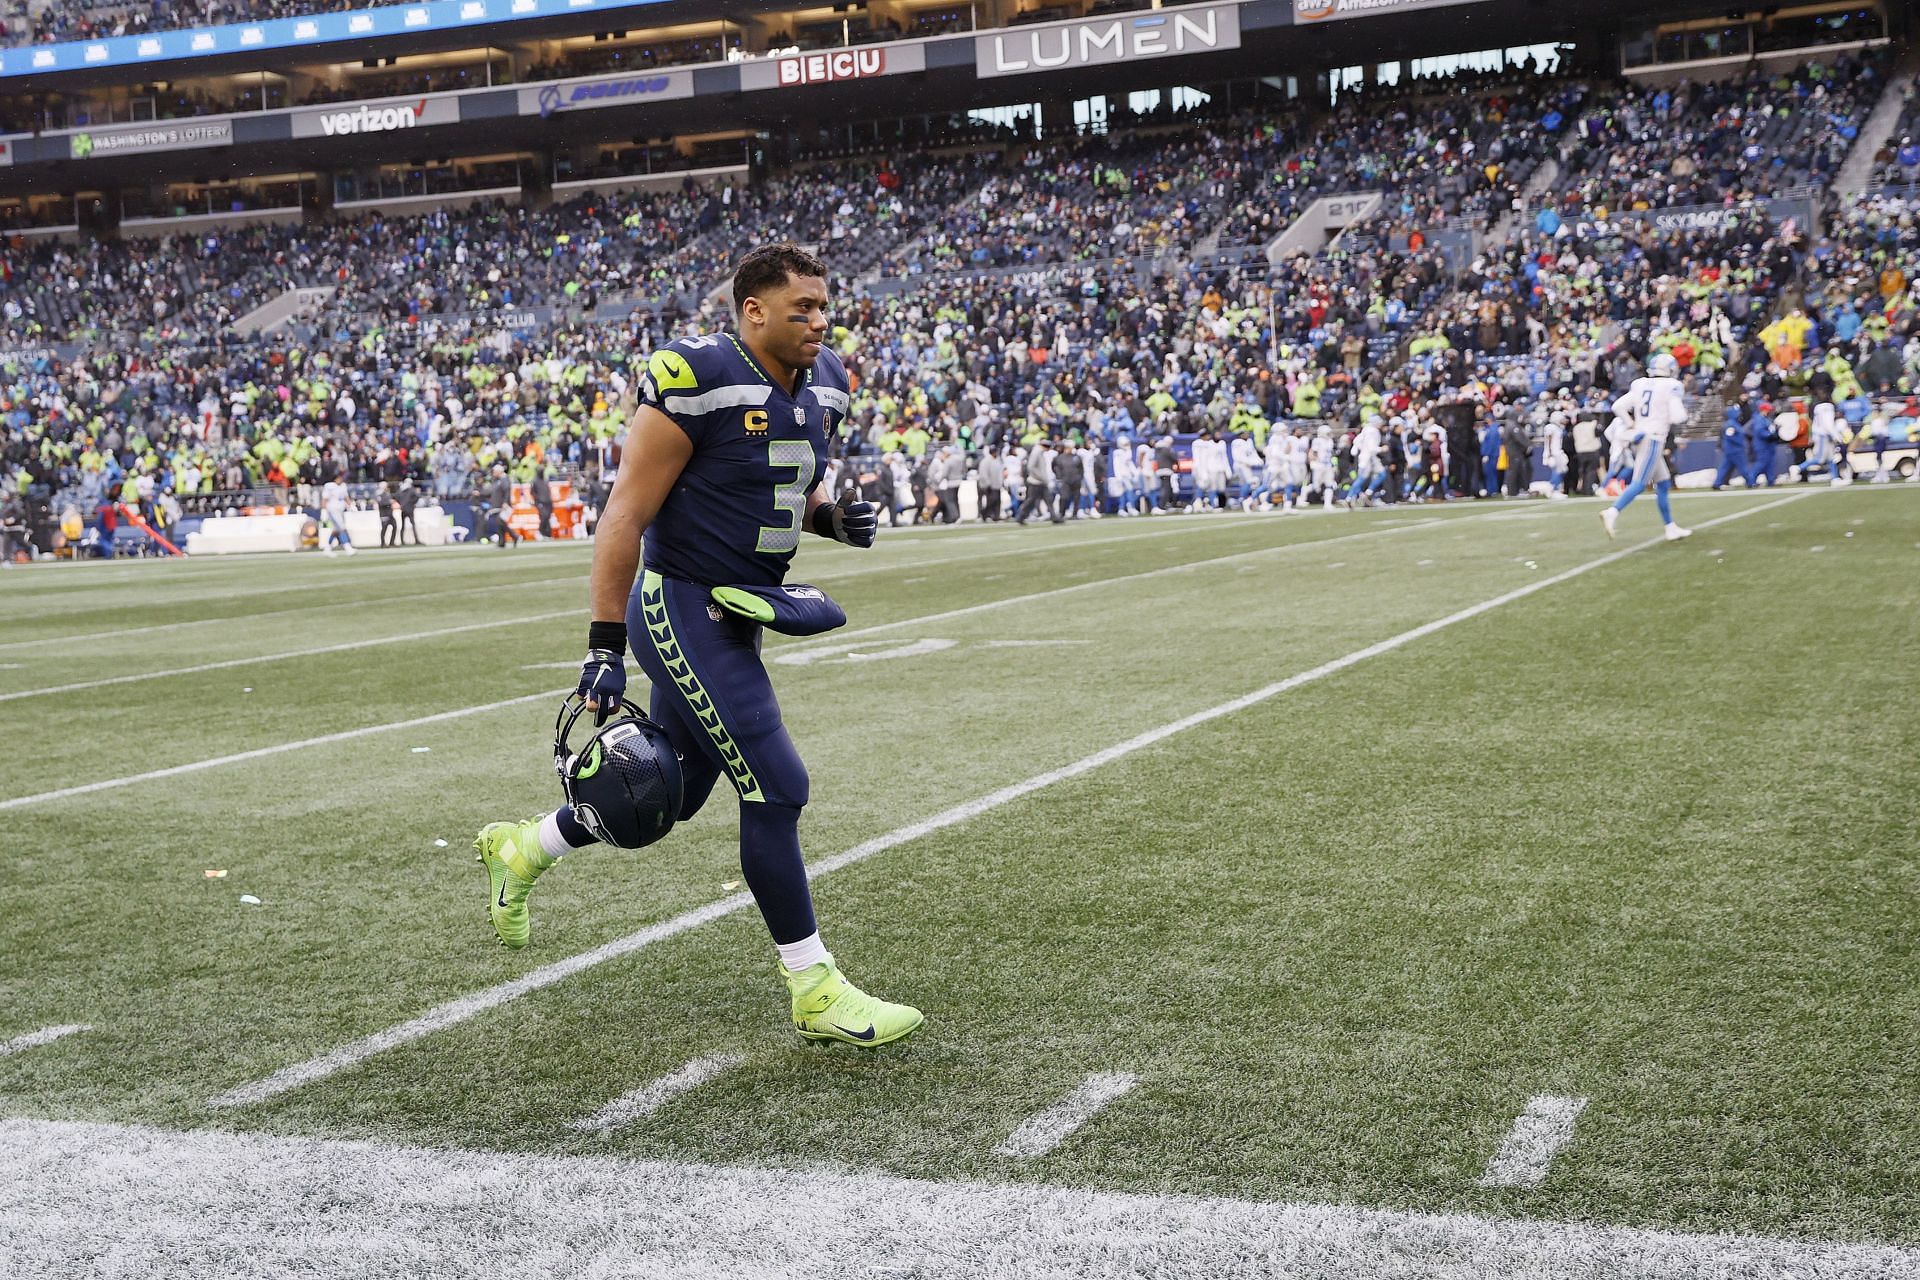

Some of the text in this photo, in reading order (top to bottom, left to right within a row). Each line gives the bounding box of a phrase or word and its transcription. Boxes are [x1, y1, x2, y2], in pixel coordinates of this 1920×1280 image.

[994, 9, 1217, 72] LUMEN
[780, 48, 880, 84] BECU
[320, 105, 416, 136] verizon
[92, 125, 228, 149] WASHINGTON'S LOTTERY
[1641, 389, 1653, 417] 3
[744, 410, 769, 431] C
[755, 440, 816, 553] 3
